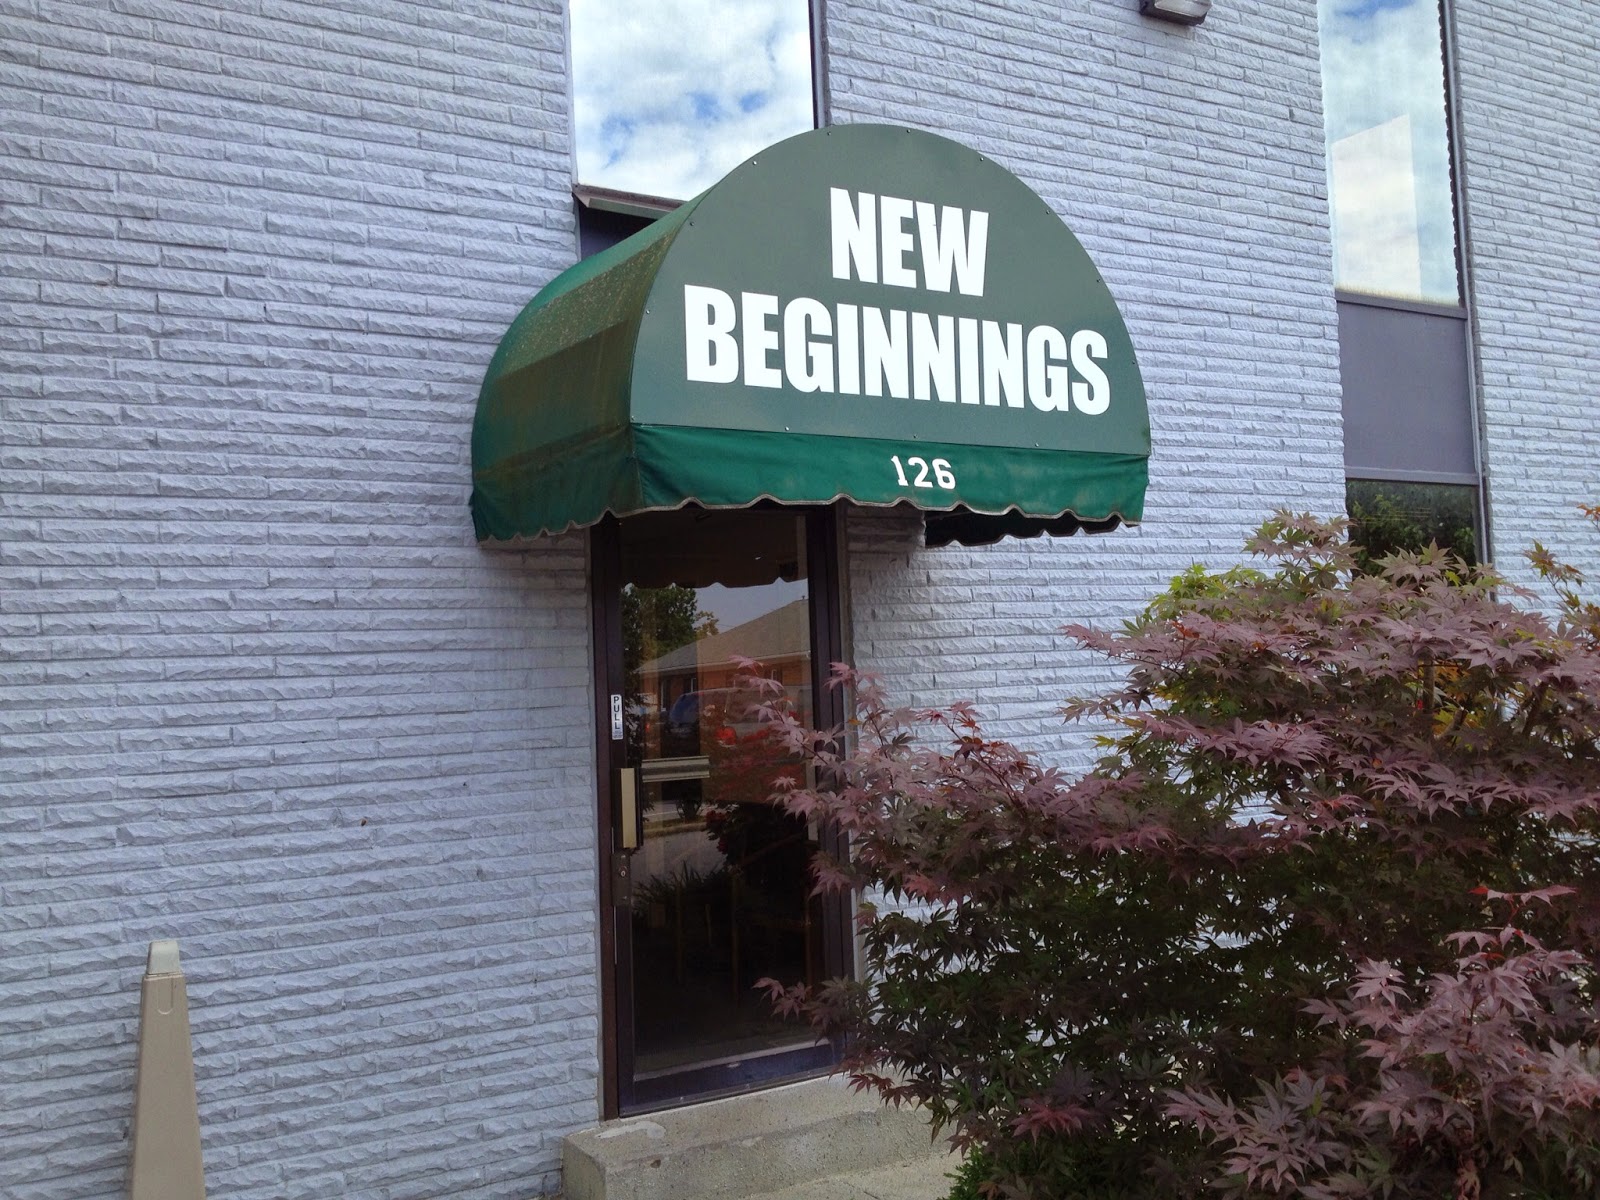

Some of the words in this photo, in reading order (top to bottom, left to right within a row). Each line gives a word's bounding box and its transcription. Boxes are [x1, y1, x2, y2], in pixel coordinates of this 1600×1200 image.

[829, 186, 989, 298] NEW
[683, 284, 1111, 416] BEGINNINGS
[891, 454, 956, 490] 126
[612, 695, 621, 730] PULL
